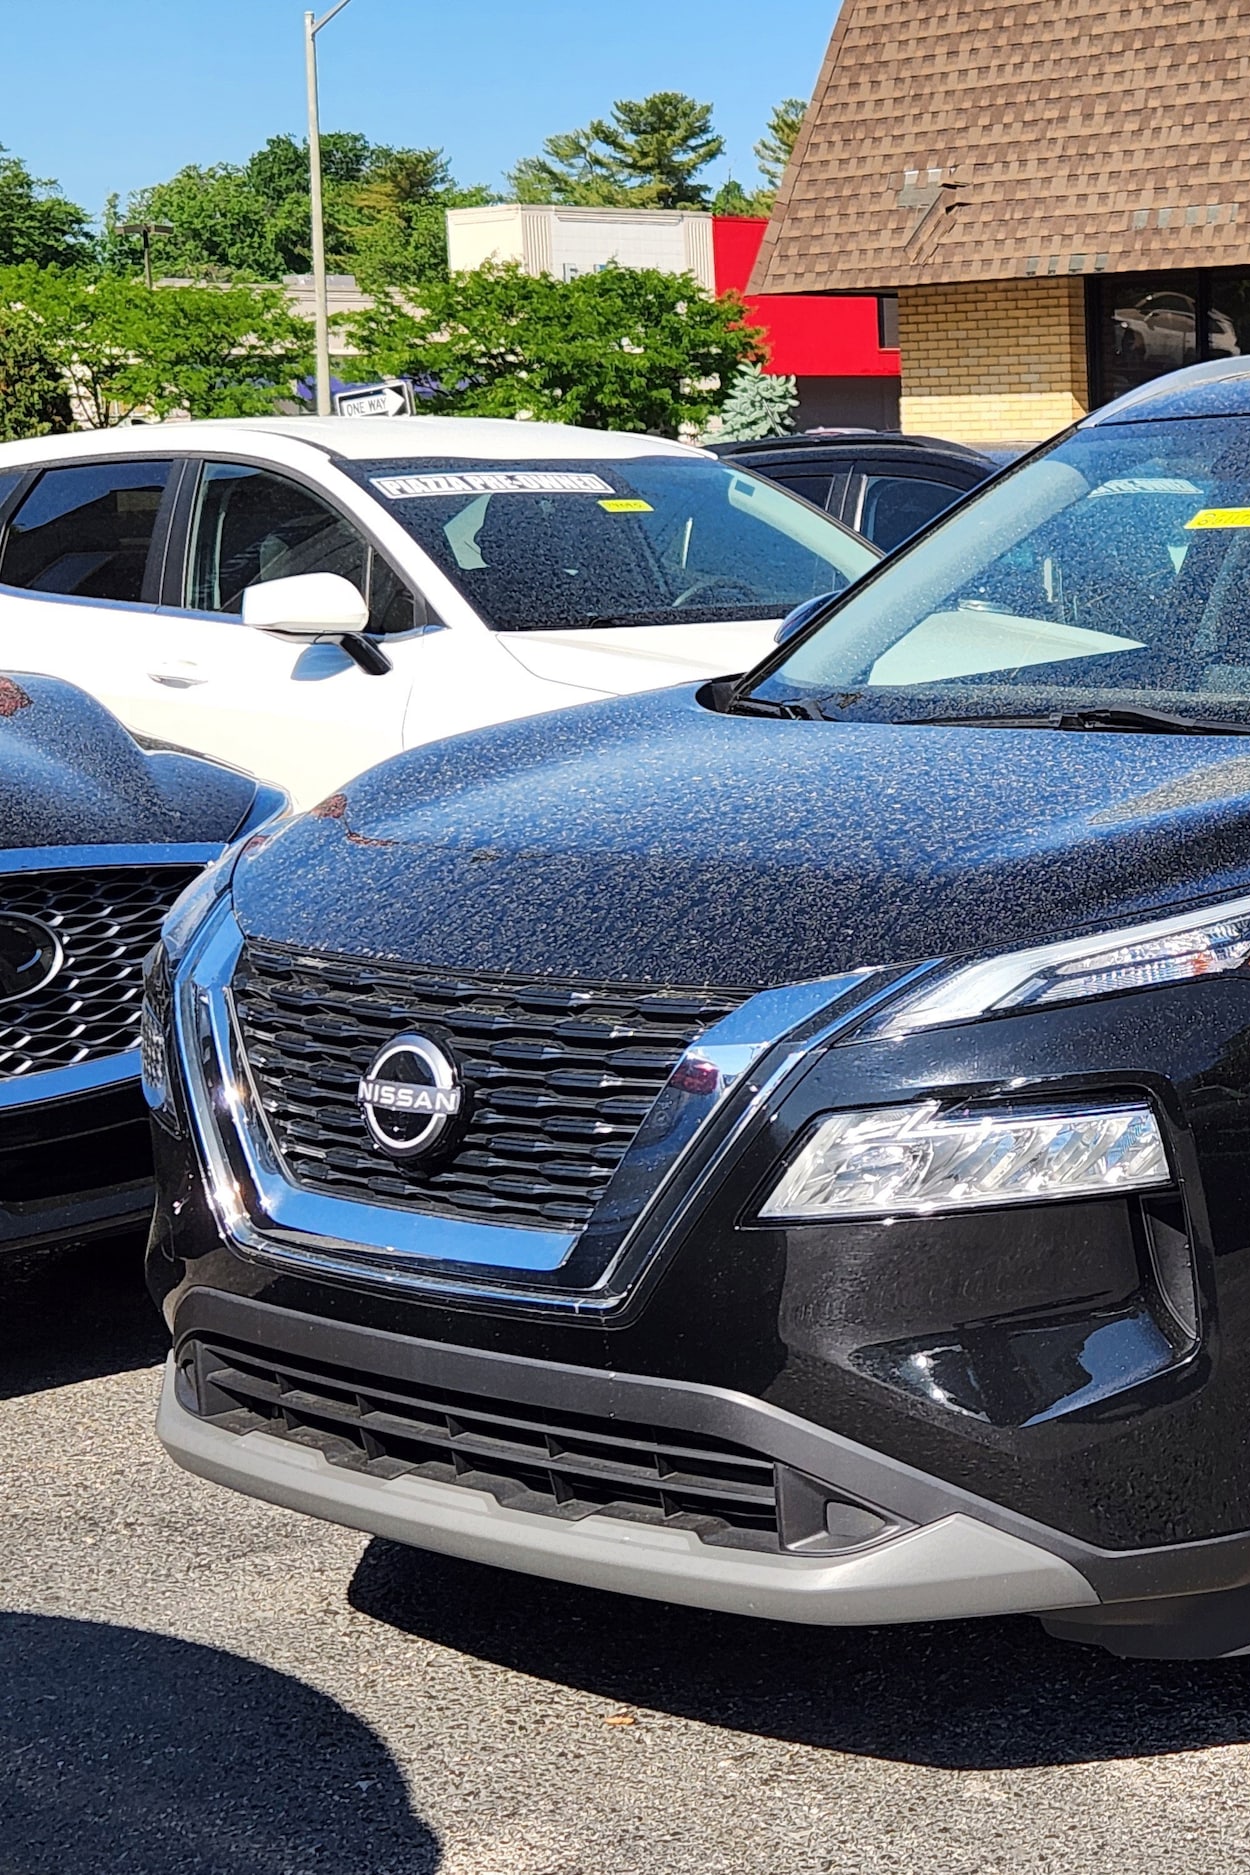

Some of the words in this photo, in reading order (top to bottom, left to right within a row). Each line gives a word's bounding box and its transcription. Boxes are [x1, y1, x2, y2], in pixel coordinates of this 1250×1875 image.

[346, 401, 366, 417] ONE
[367, 397, 387, 412] WAY
[379, 476, 474, 496] PIAZZA
[462, 474, 606, 492] PRE-OWNED
[359, 1082, 457, 1111] NISSAN
